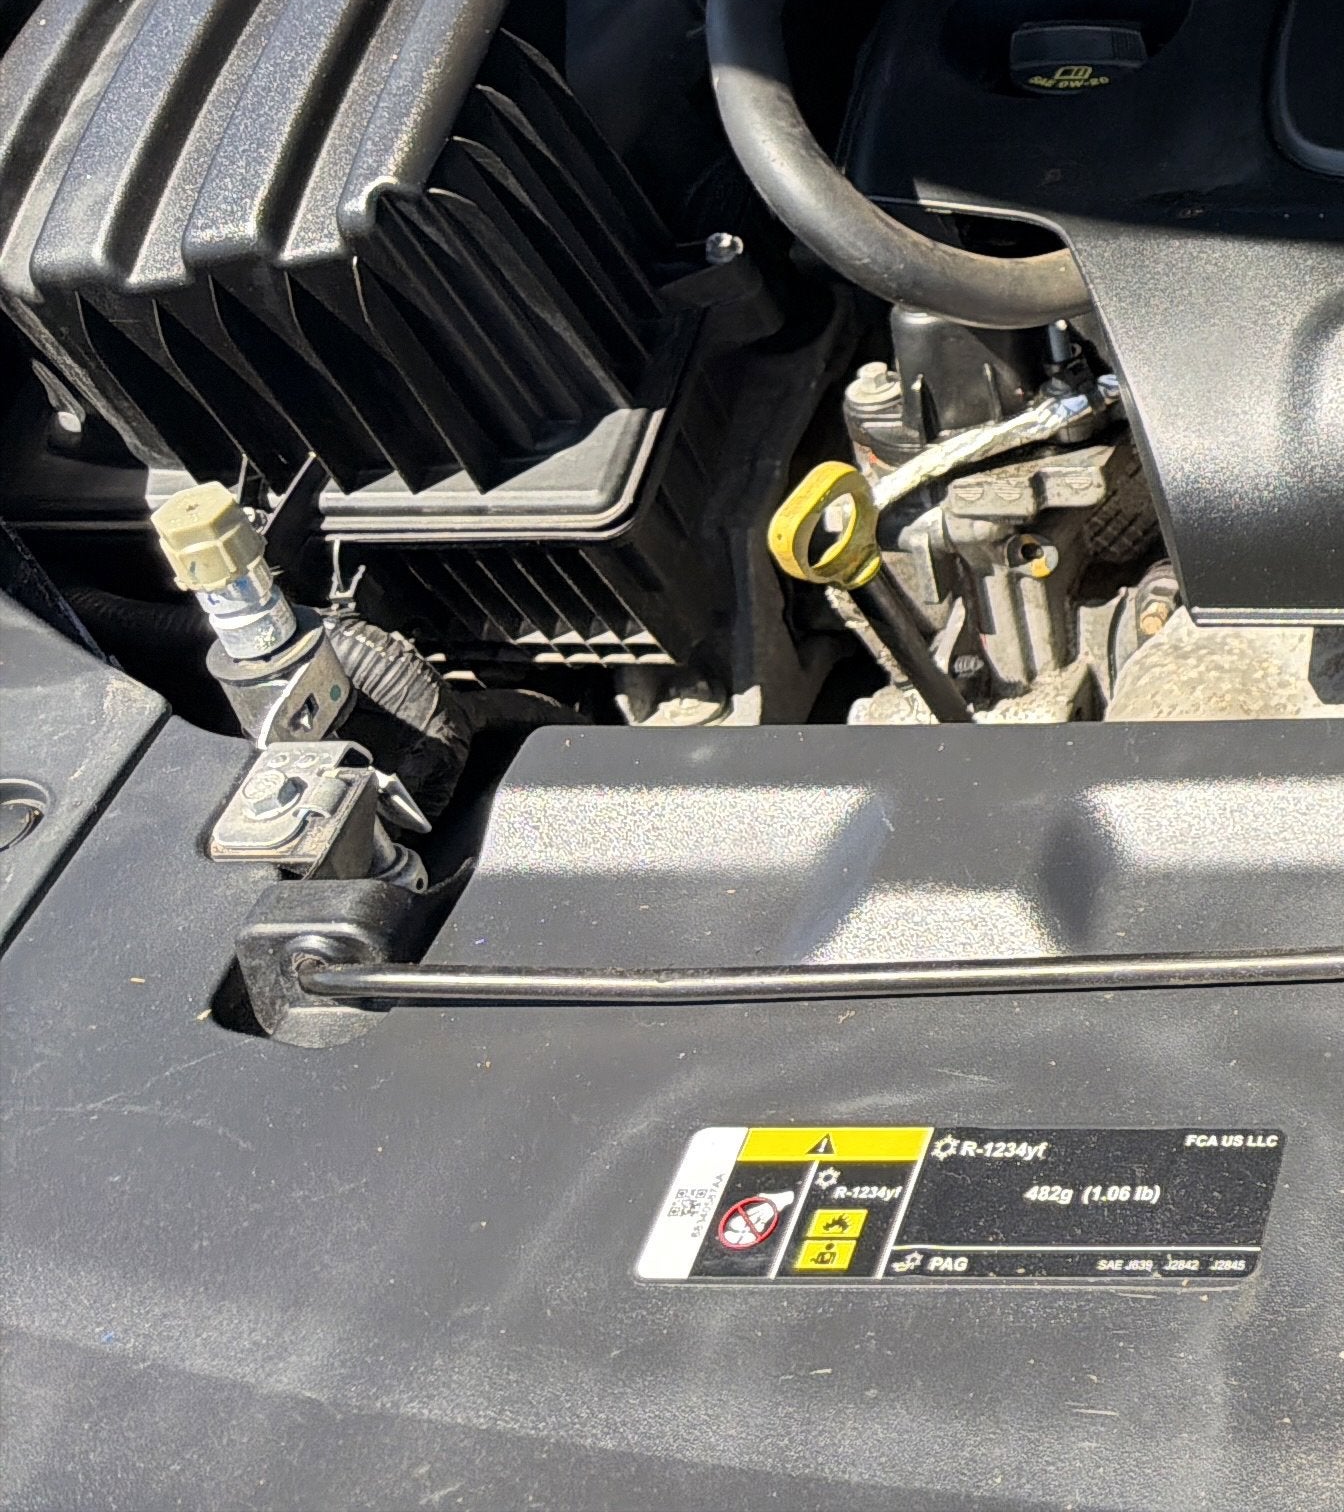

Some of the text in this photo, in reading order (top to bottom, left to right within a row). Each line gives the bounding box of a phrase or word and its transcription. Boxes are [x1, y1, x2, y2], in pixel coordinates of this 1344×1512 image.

[1184, 1134, 1279, 1147] FCA US LLC
[958, 1140, 1049, 1161] R-1234yf
[1023, 1184, 1161, 1205] 482g (1.06 lb)
[927, 1256, 969, 1272] PAG
[1096, 1259, 1124, 1271] SAE
